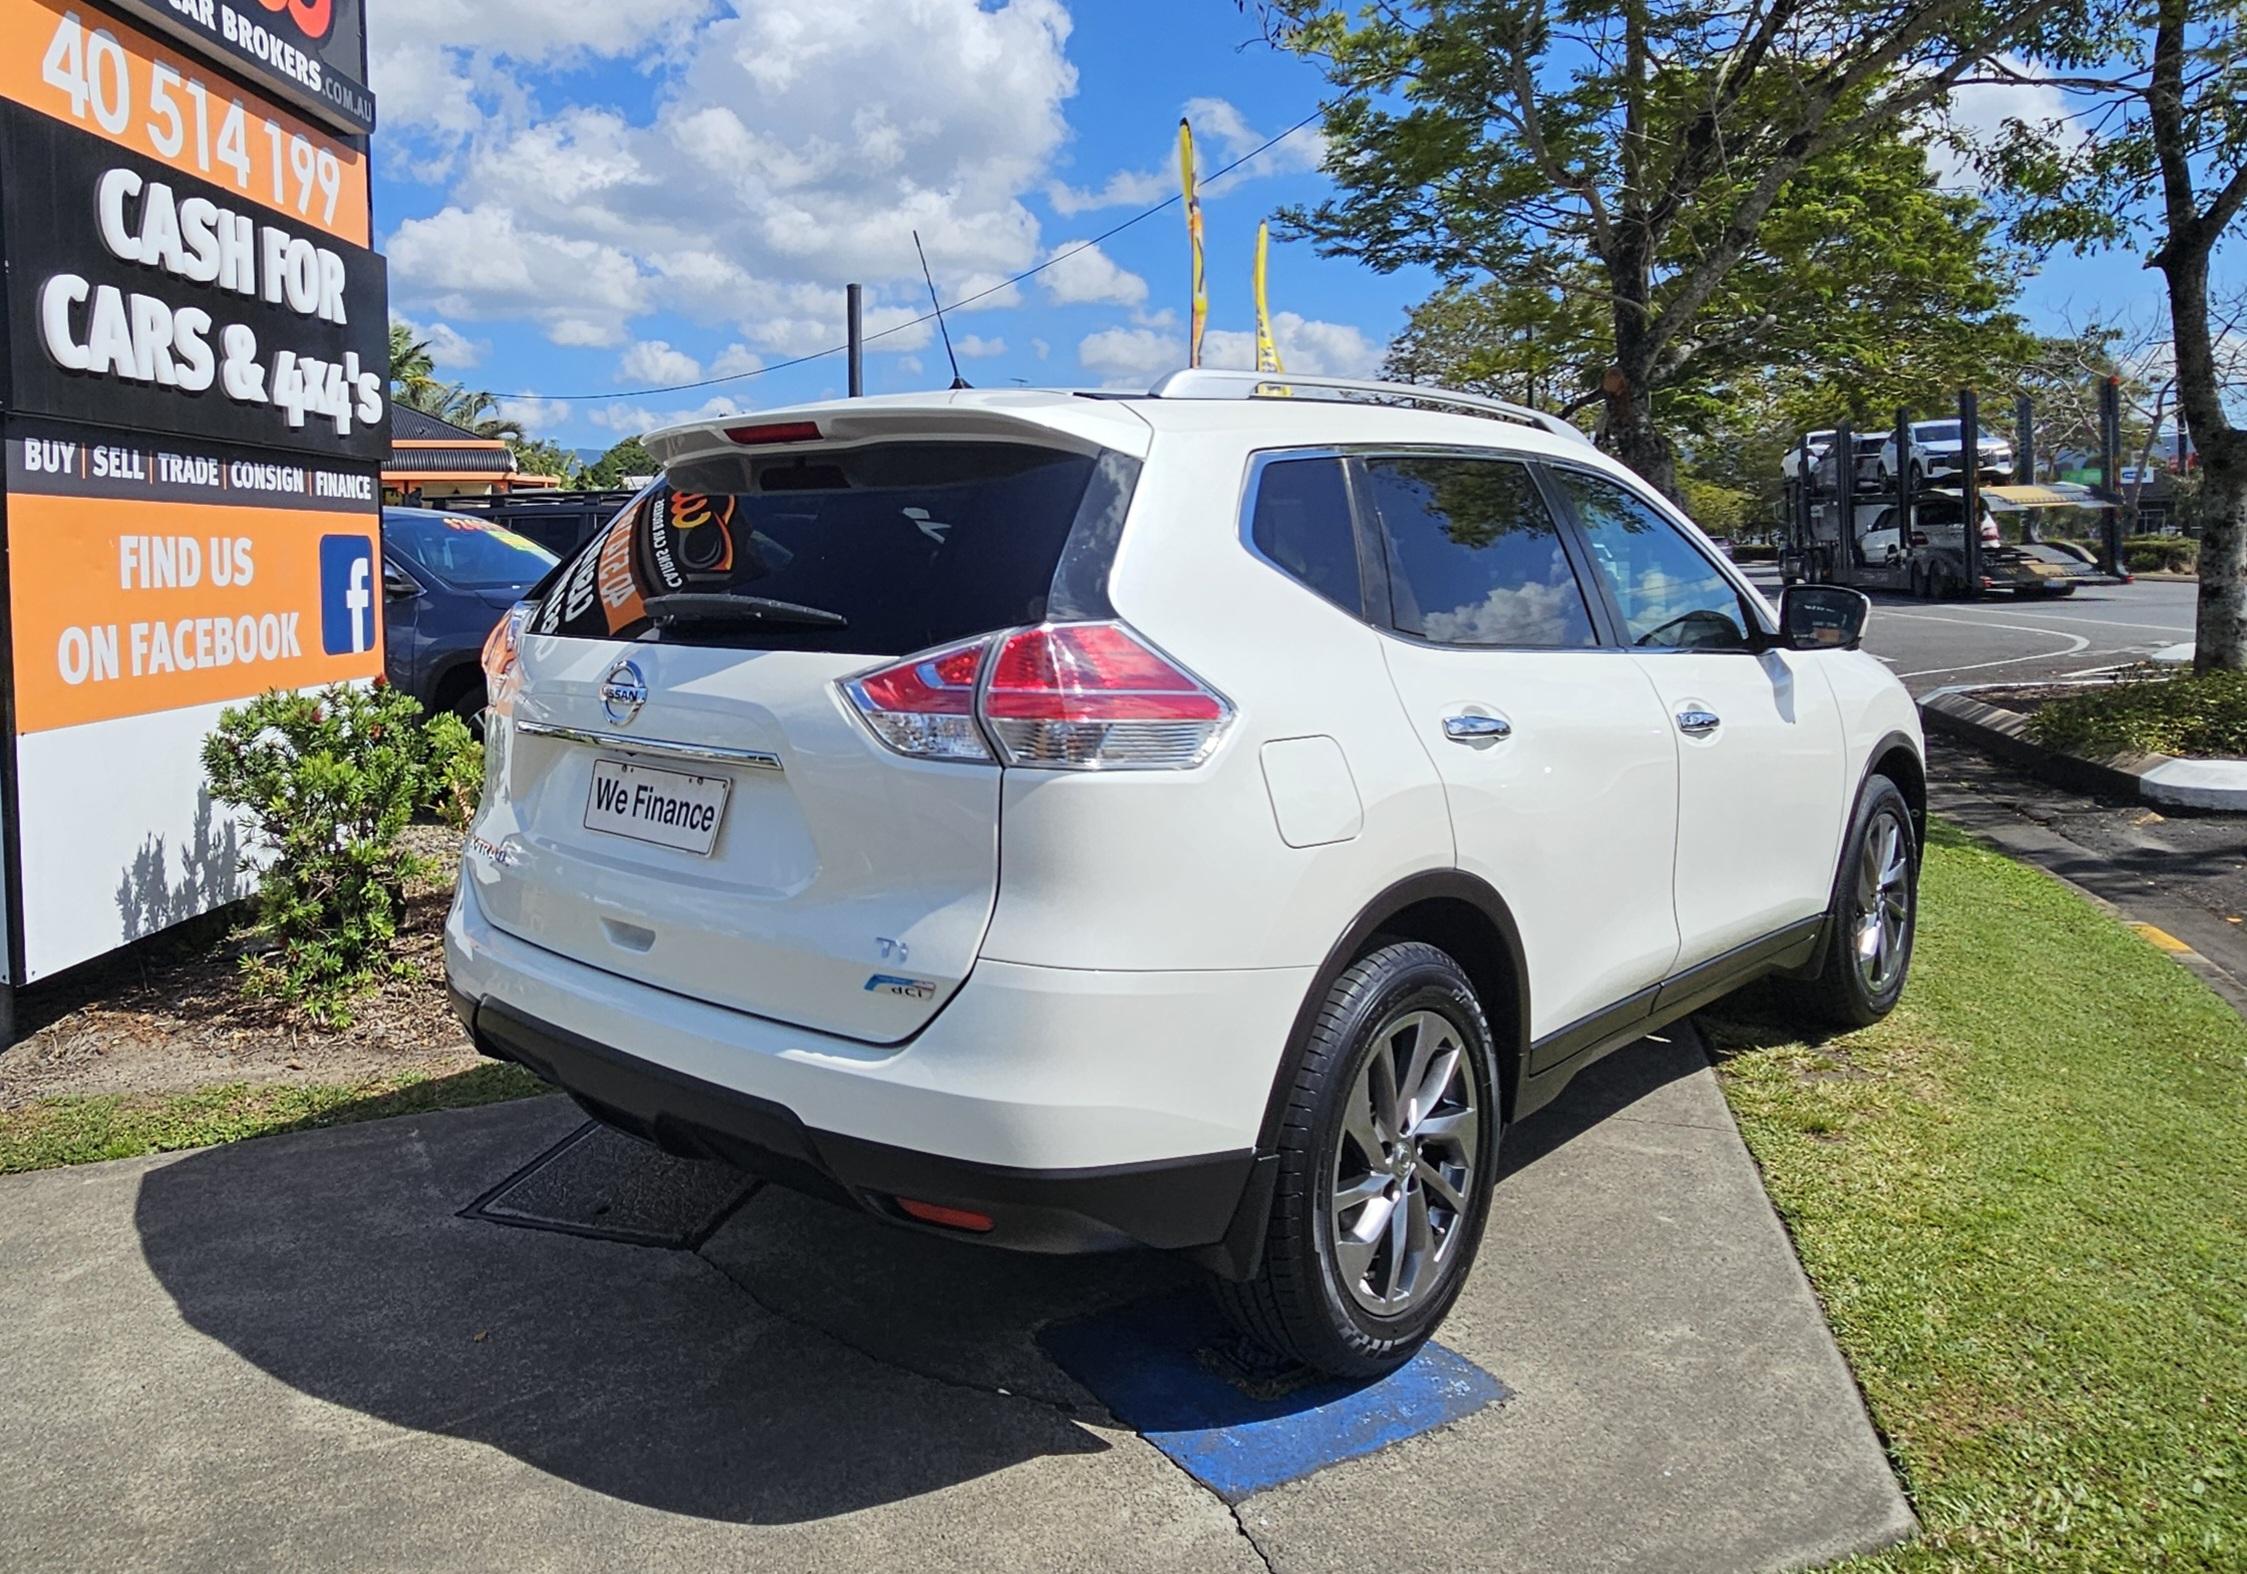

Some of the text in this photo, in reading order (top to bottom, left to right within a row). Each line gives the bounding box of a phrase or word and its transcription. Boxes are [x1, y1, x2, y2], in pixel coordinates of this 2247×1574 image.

[42, 10, 341, 227] 40 514 199
[98, 167, 347, 325] CASH FOR
[41, 273, 216, 392] CARS
[222, 323, 269, 403] &
[24, 438, 372, 500] BUY SELL TRADE CONSIGN FINANCE
[119, 535, 255, 591] FIND US
[57, 611, 302, 686] ON FACEBOOK
[596, 776, 715, 833] We Finance
